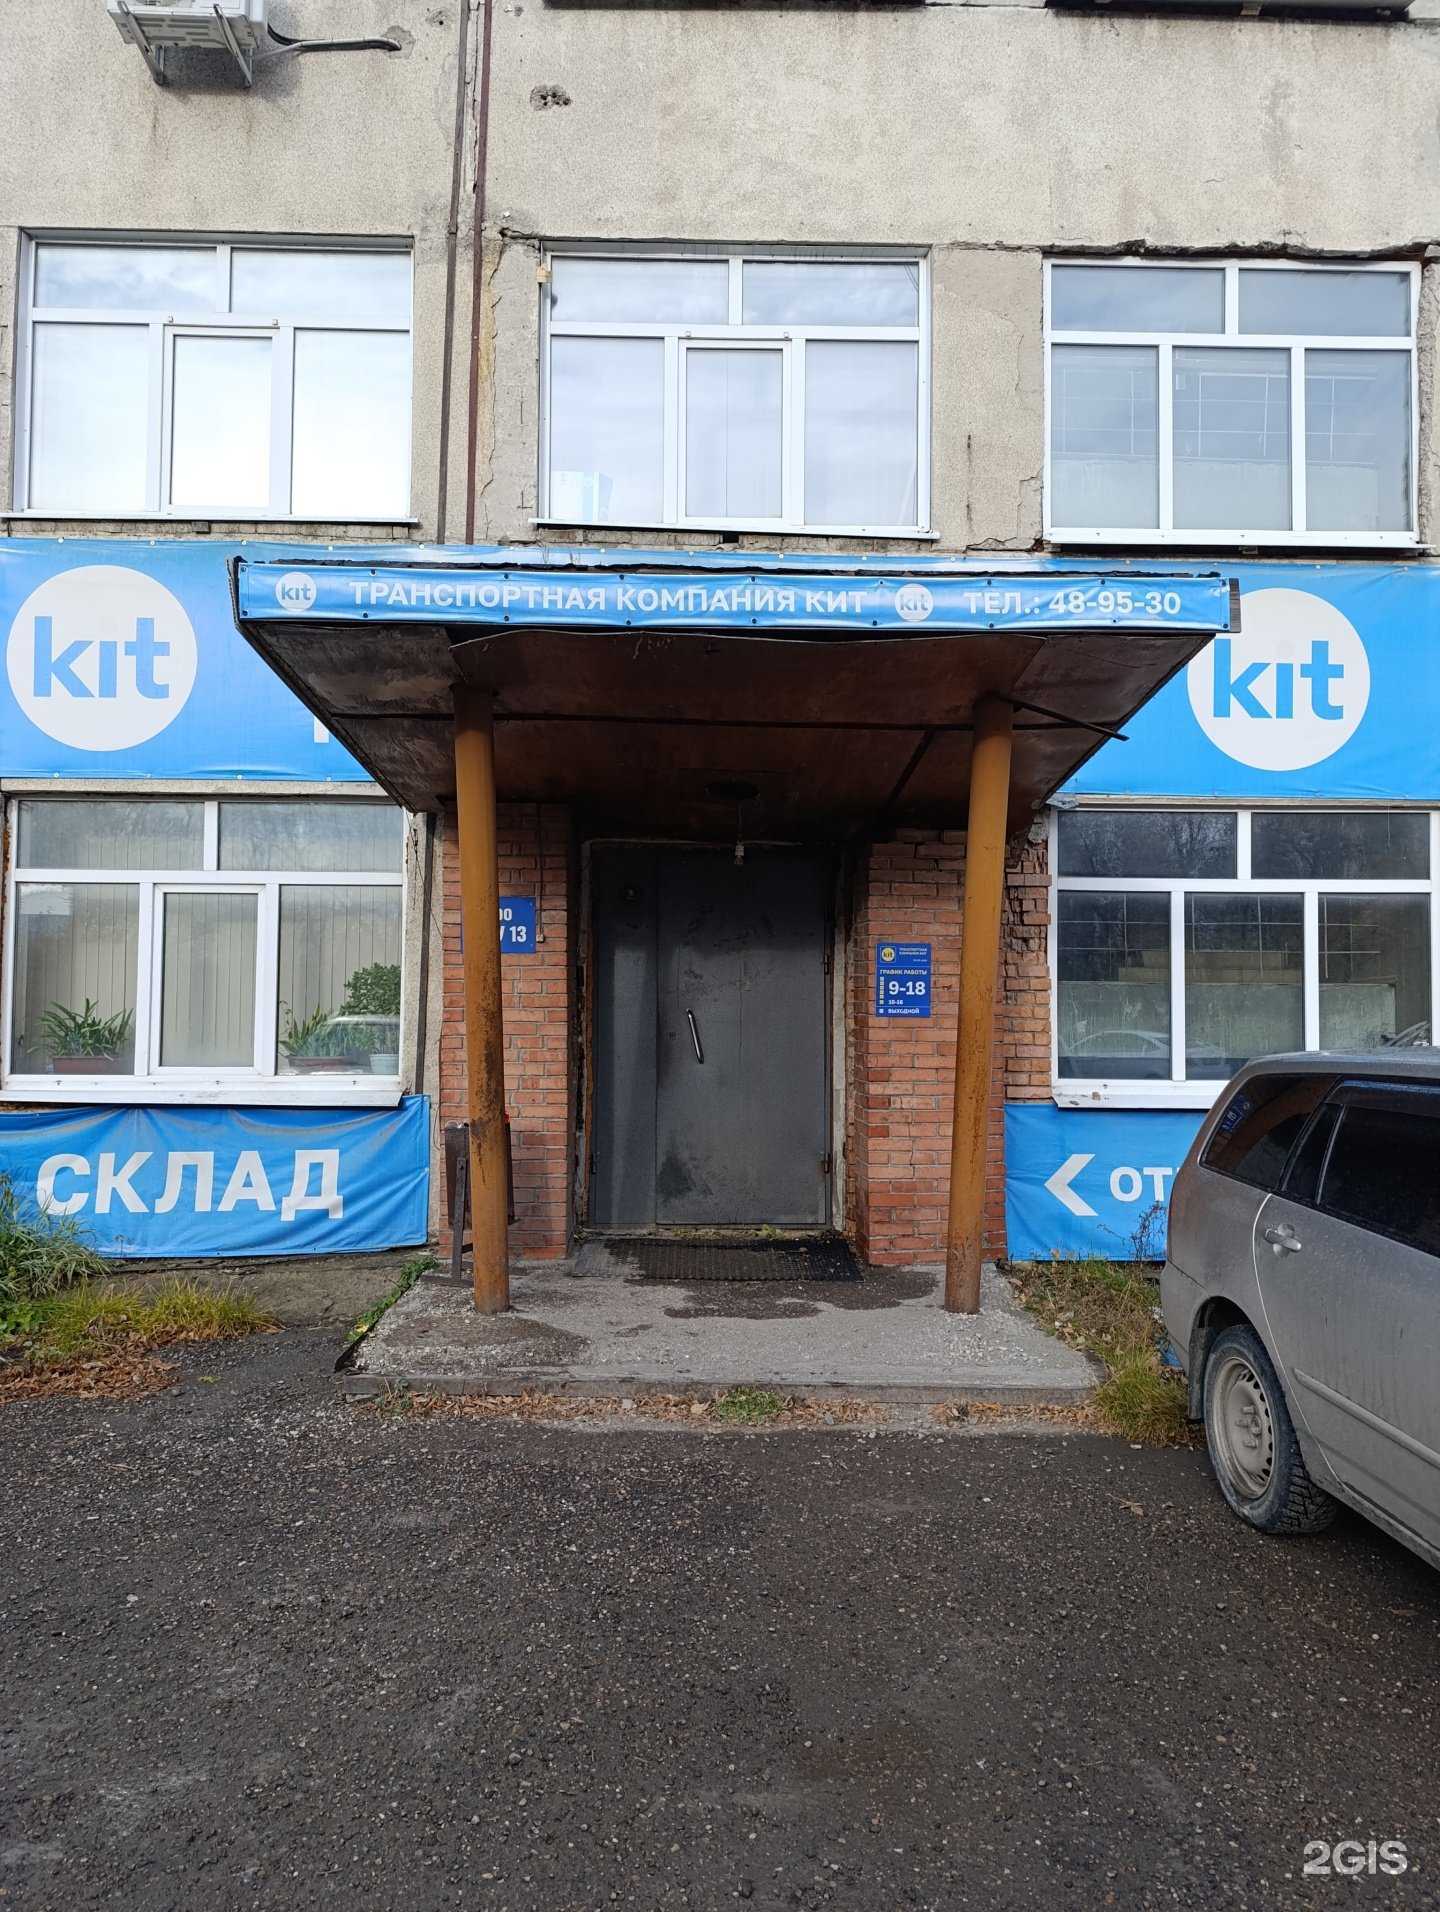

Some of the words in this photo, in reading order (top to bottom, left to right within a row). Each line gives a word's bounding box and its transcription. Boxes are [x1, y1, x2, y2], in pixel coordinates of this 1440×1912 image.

[350, 581, 606, 611] ТРАНСПОРТНАЯ
[616, 586, 796, 613] КОМПАНИЯ
[806, 590, 867, 613] КИТ
[962, 592, 1040, 615] ТЕЛ.:
[1048, 591, 1182, 615] 48-95-30
[888, 981, 926, 996] 9-18
[36, 1149, 344, 1222] СКЛАД
[1109, 1166, 1179, 1202] ОТ
